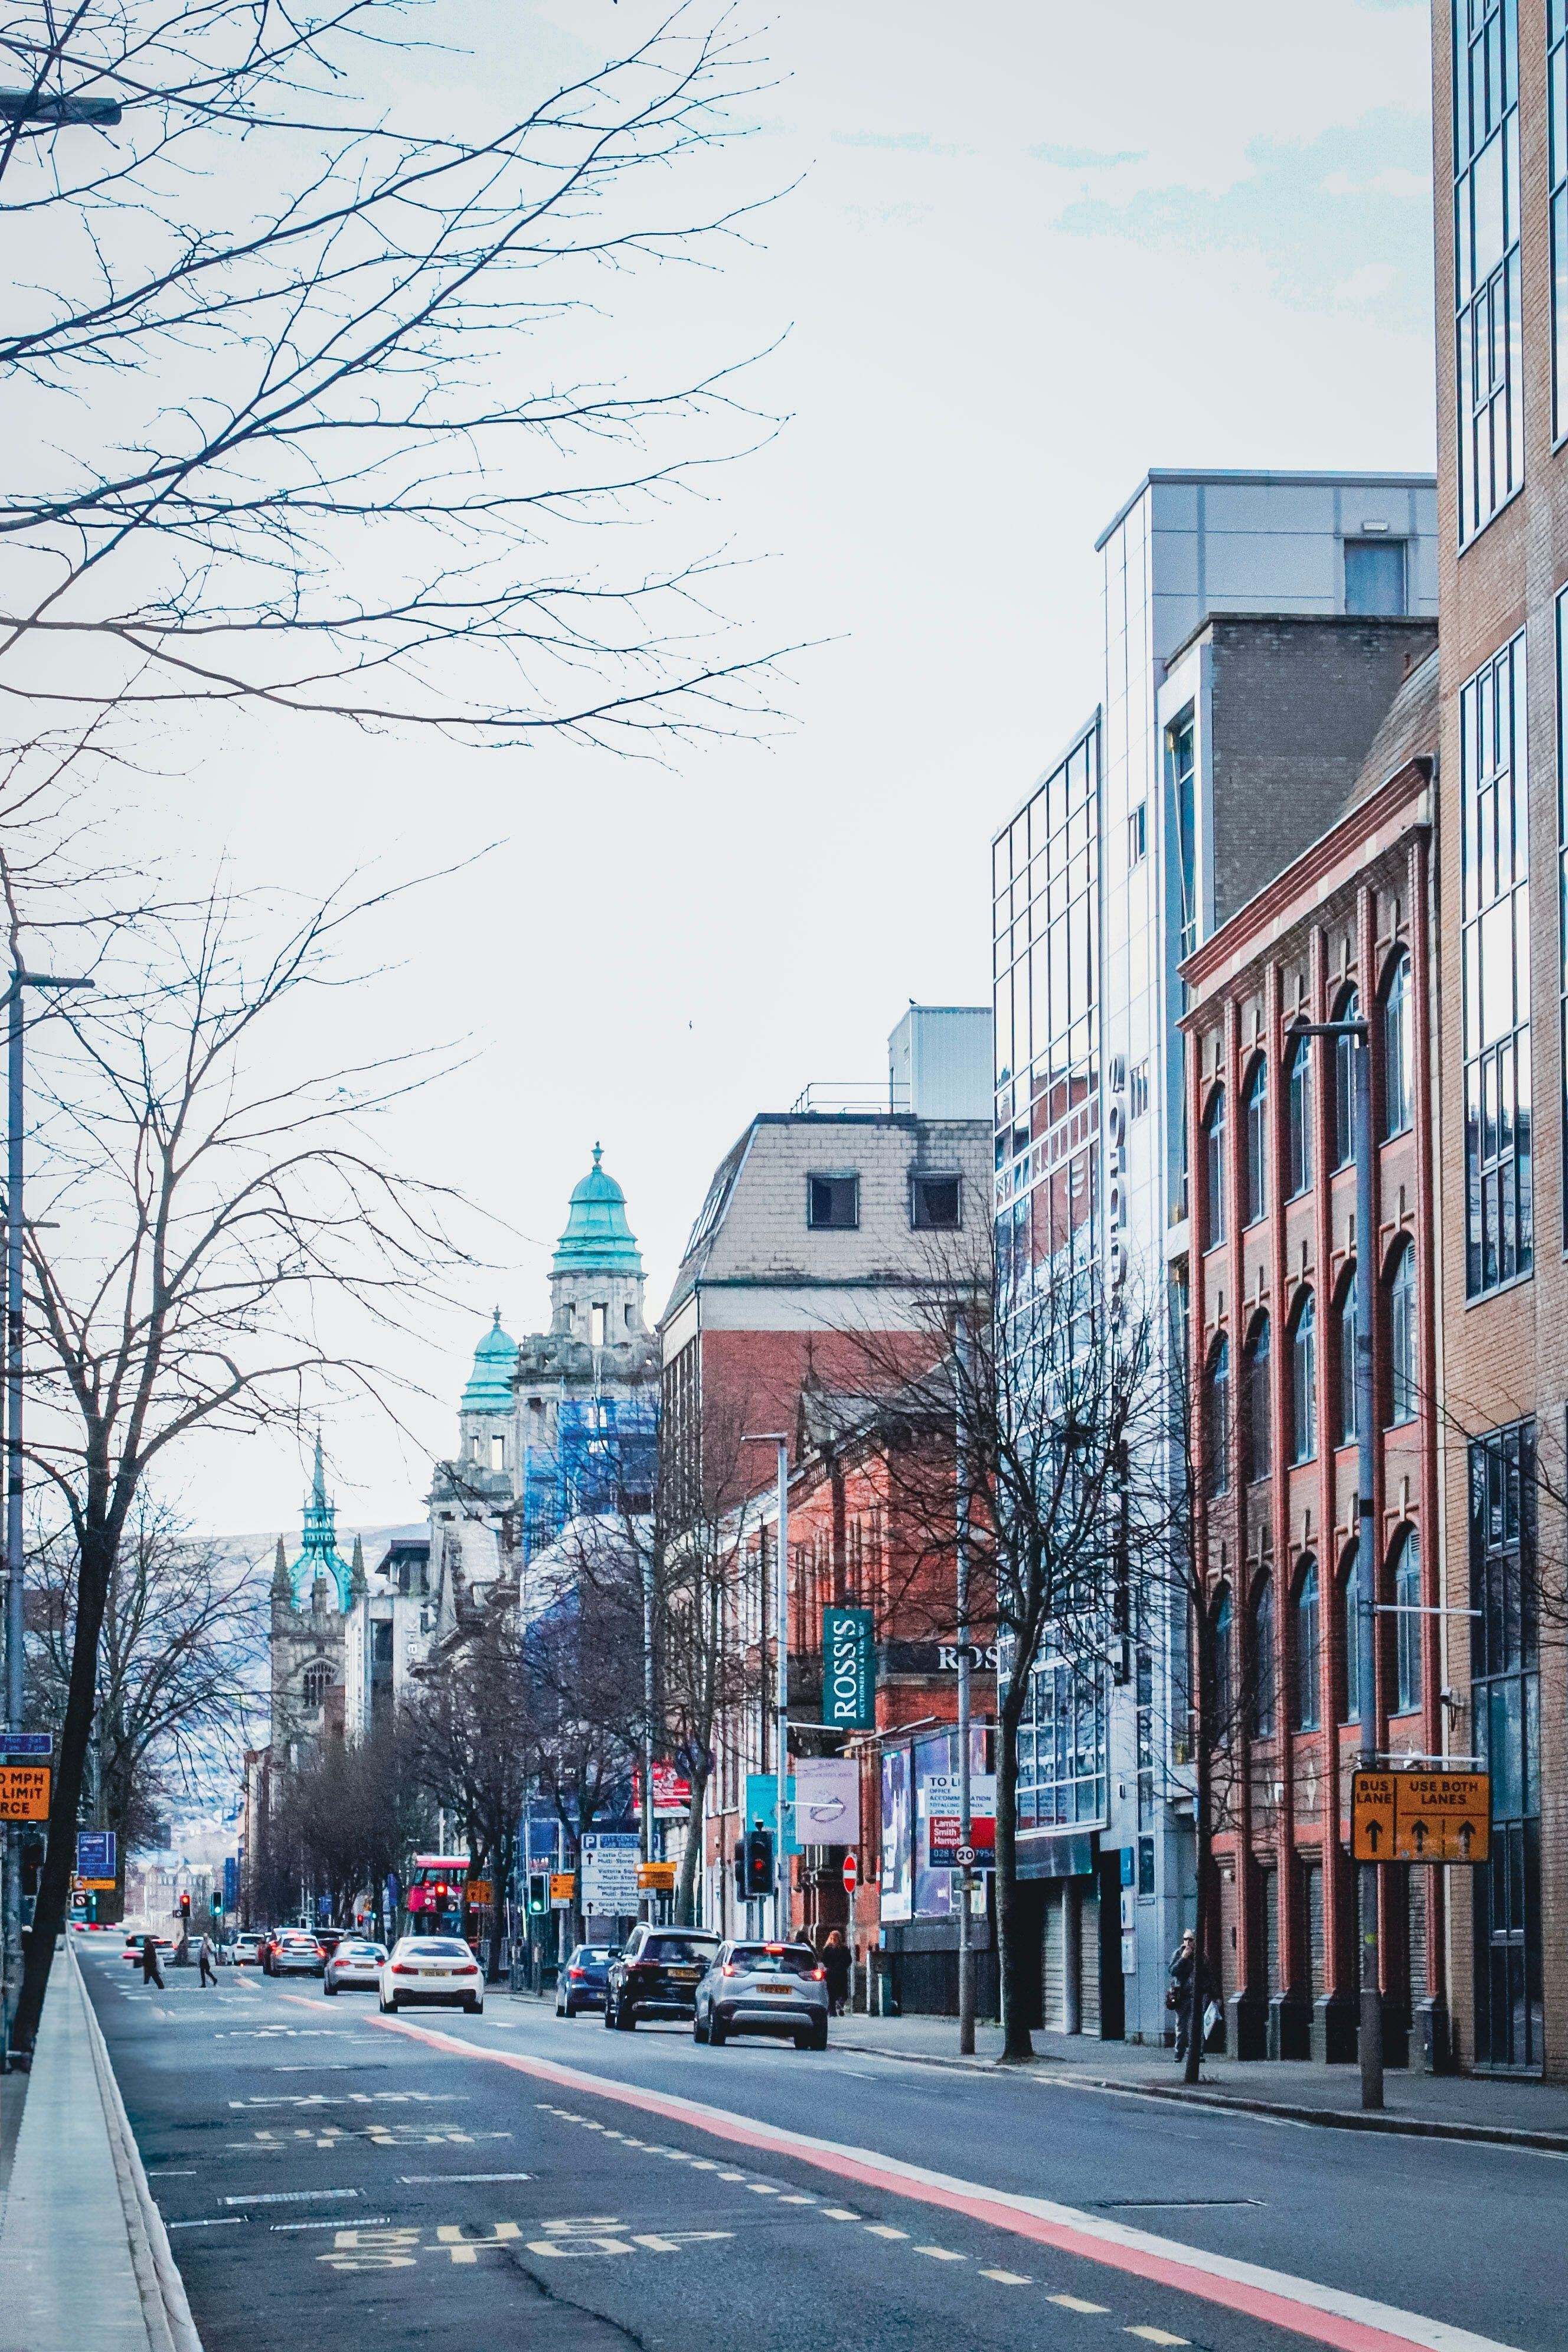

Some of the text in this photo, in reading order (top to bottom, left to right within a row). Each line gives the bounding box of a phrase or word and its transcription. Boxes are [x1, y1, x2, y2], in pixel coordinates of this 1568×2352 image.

[833, 1619, 857, 1719] ROSS'S
[11, 1773, 44, 1785] MPH
[930, 1777, 947, 1787] TO
[1360, 1780, 1389, 1792] BUS
[1410, 1781, 1478, 1792] USE BOTH
[2, 1788, 43, 1799] LIMIT
[1356, 1793, 1392, 1804] LANE
[1421, 1794, 1466, 1805] LANES
[934, 1827, 957, 1836] Smith
[934, 1836, 961, 1846] Hampt
[933, 1849, 949, 1857] 028
[958, 1851, 974, 1860] 20
[254, 2124, 465, 2139] BUS
[225, 2132, 513, 2150] STOP
[334, 2217, 631, 2248] BUS
[315, 2232, 737, 2270] STOP
